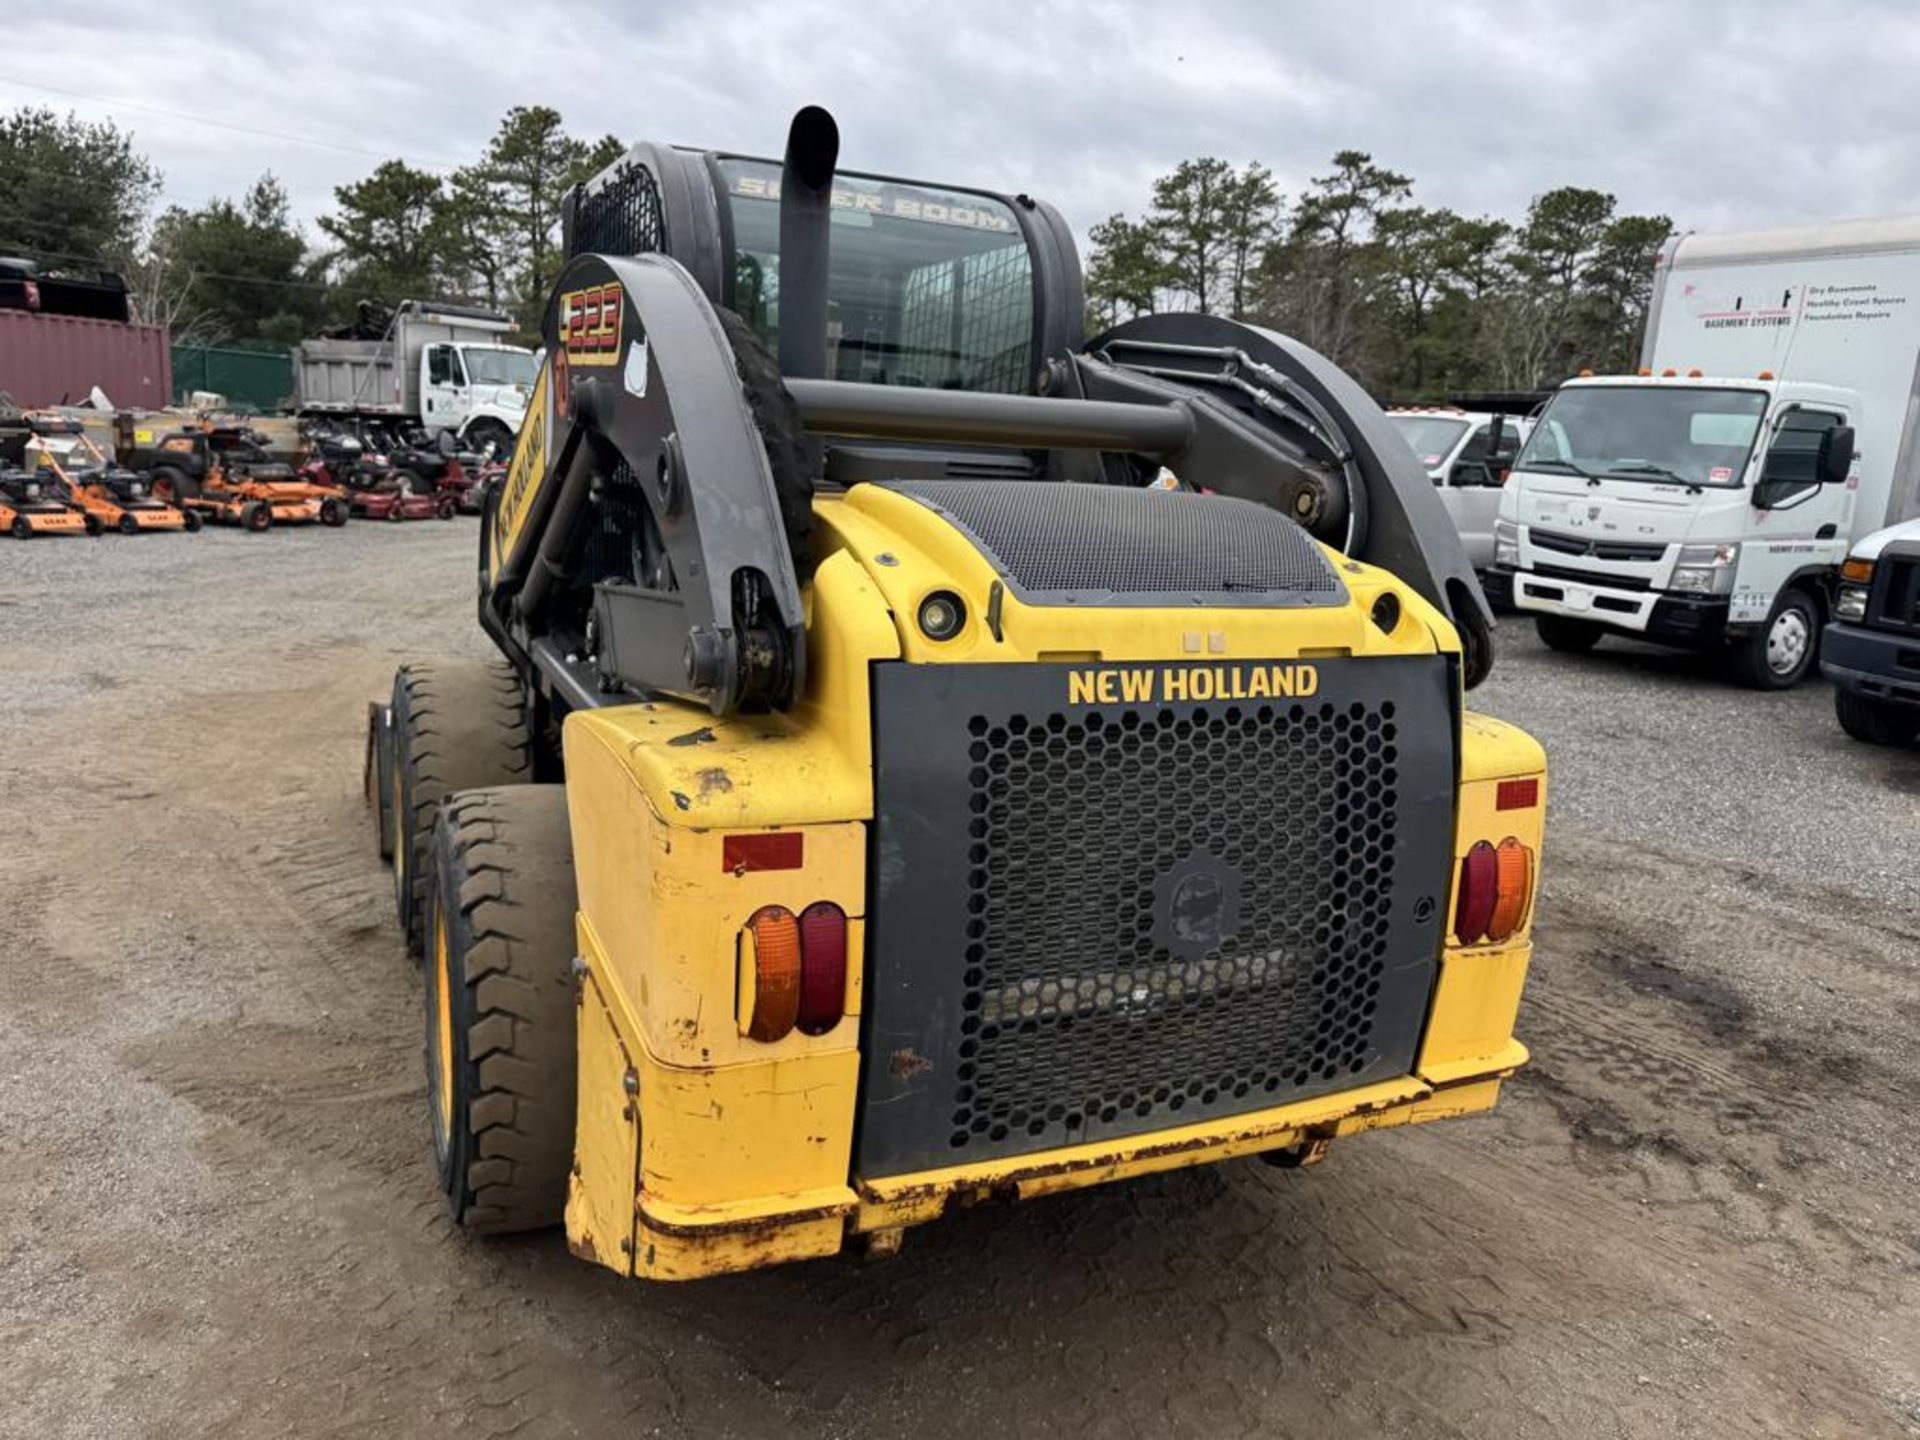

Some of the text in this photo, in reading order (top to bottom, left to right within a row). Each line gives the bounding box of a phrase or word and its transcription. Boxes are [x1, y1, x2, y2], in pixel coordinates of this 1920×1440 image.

[737, 176, 1011, 231] SER BOOM
[1809, 286, 1825, 295] Dry
[1806, 299, 1840, 309] Healthy
[1704, 316, 1792, 329] BASEMENT SYSTEMS
[1068, 664, 1319, 705] NEW HOLLAND
